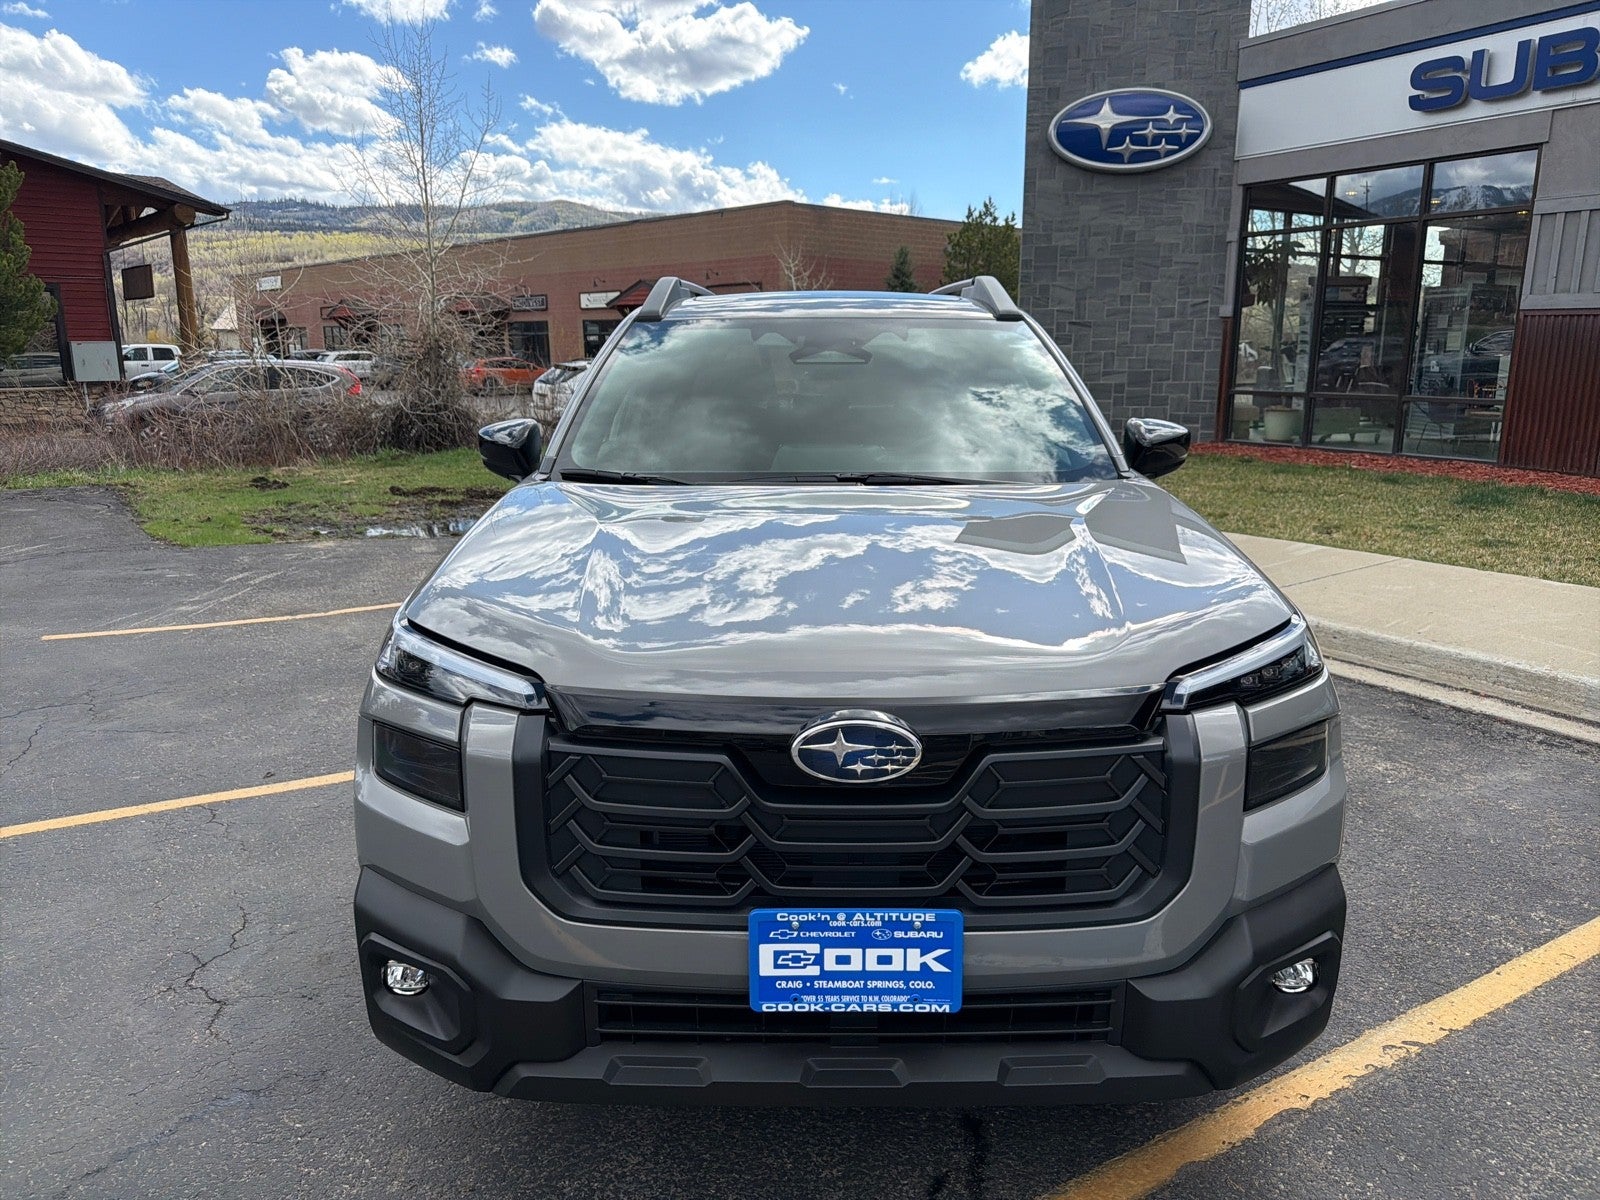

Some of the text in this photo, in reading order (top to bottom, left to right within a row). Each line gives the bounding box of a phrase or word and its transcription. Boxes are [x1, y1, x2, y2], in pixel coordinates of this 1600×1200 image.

[776, 912, 936, 922] Cook'n @ ALTITUDE
[829, 919, 882, 927] cook-cars.com
[893, 931, 944, 939] SUBARU
[759, 943, 952, 976] COOK
[775, 980, 936, 990] CRAIG STEAMBOAT SPRINGS, COLO.
[817, 995, 824, 1003] 55
[825, 995, 840, 1003] YEARS
[841, 995, 860, 1003] SERVICE
[861, 995, 868, 1003] TO
[761, 1003, 951, 1013] COOK-CARS.COM
